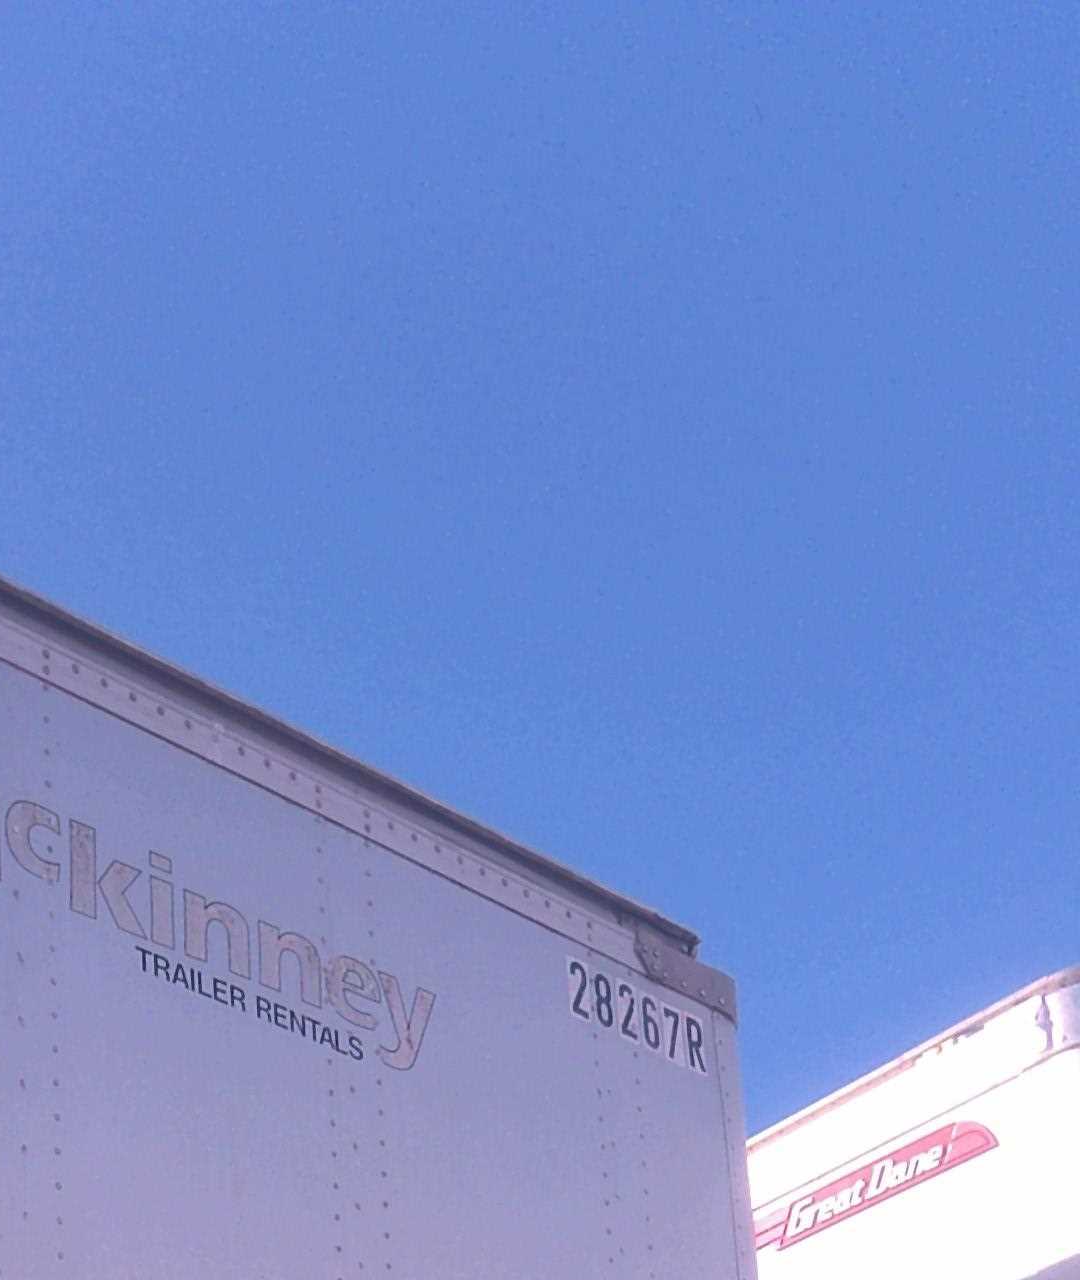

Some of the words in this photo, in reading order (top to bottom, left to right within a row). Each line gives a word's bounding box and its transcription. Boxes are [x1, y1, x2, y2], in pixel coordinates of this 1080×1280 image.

[135, 946, 246, 1012] TRAILER
[256, 996, 364, 1061] RENTALS
[570, 961, 706, 1073] 28267R
[786, 1196, 866, 1239] Great
[865, 1144, 943, 1201] Dane
